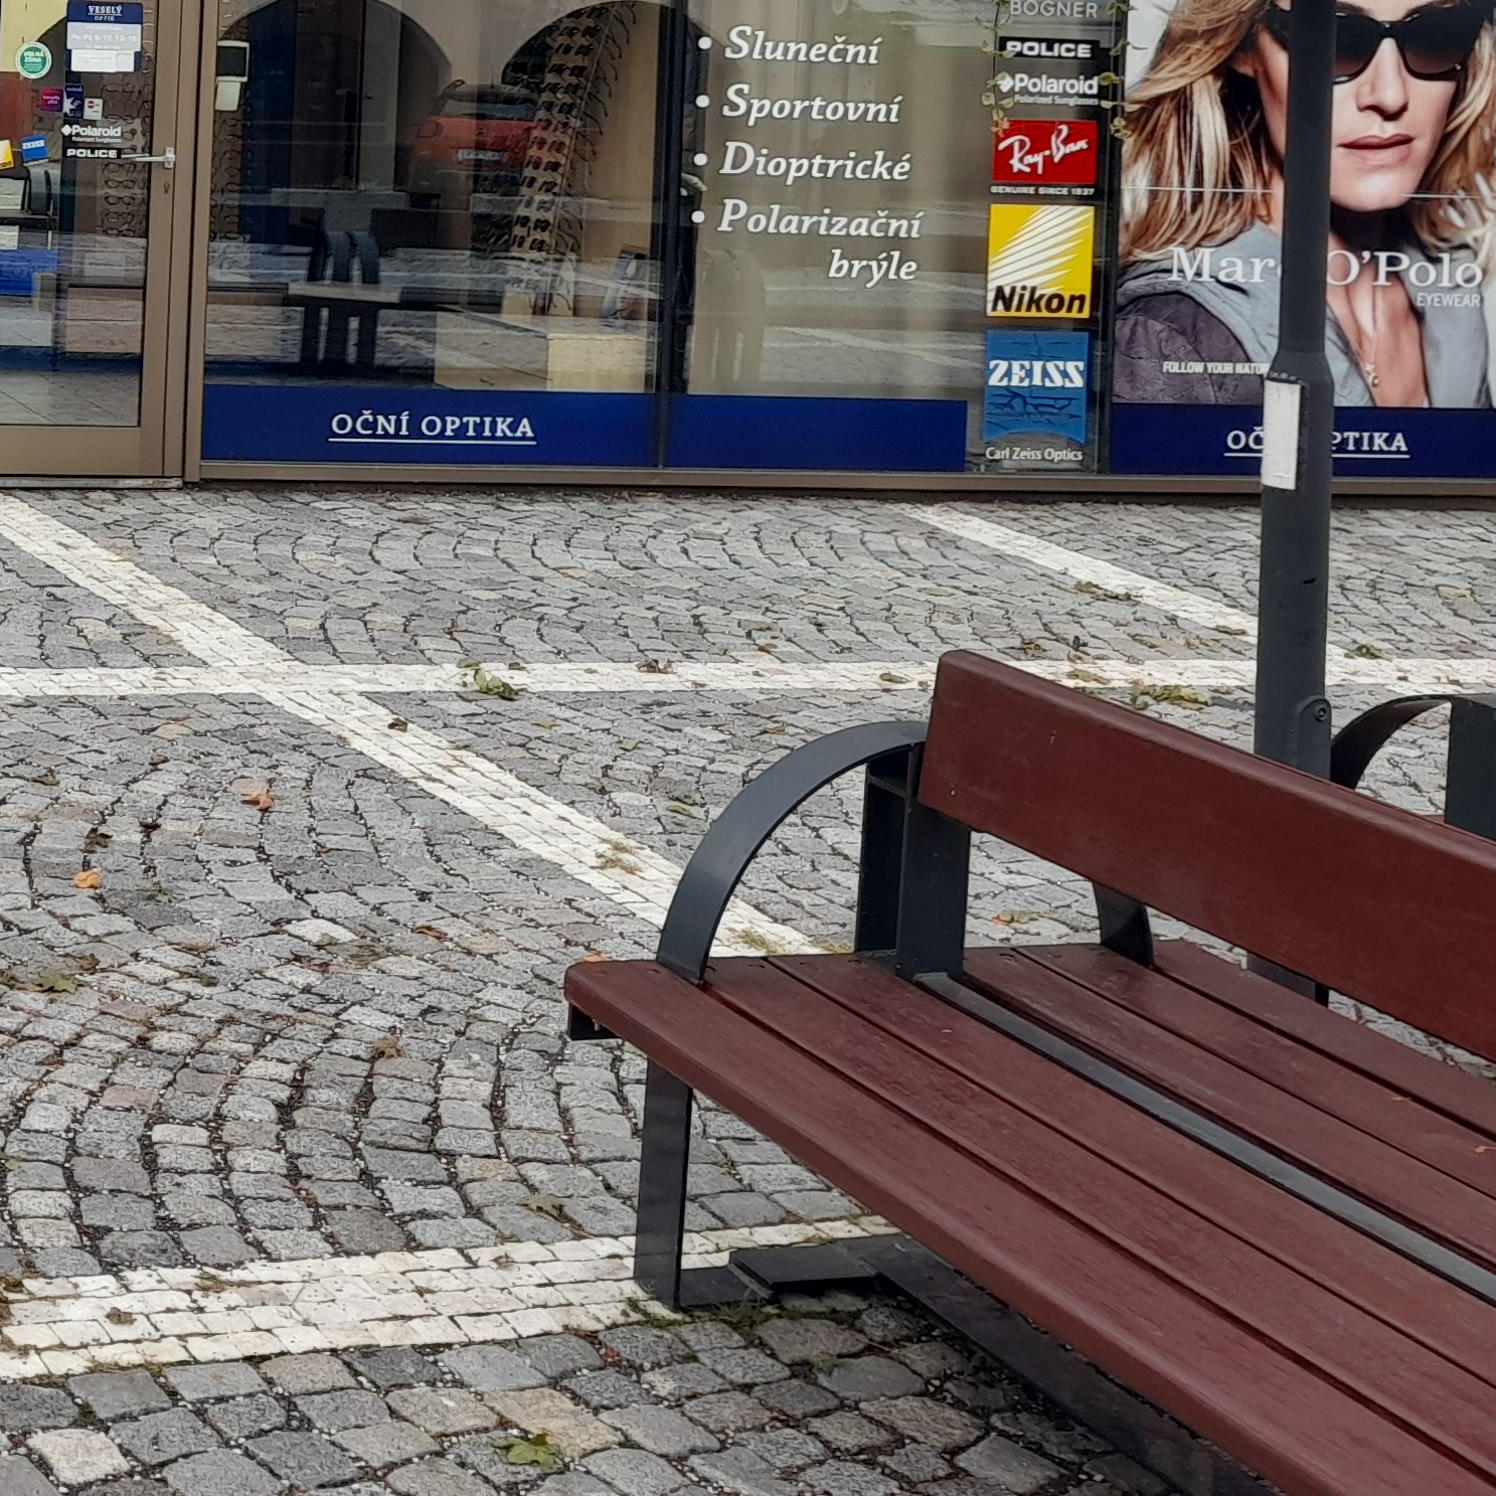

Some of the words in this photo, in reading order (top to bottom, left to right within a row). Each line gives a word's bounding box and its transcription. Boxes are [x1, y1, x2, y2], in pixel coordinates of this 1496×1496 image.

[1010, 0, 1098, 18] BOGNER
[724, 24, 882, 65] Sluneční
[1006, 41, 1092, 58] POLICE
[1014, 73, 1099, 94] Polaroid
[721, 82, 903, 126] Sportovní
[72, 125, 121, 137] Polaroid
[67, 149, 118, 159] POLICE
[719, 141, 912, 185] Dioptrické
[998, 124, 1089, 175] Ray-Ban
[717, 197, 922, 238] Polarizační
[828, 249, 918, 288] brýle
[1167, 247, 1281, 283] Mar
[1327, 250, 1483, 288] O'Polo
[991, 285, 1086, 315] Nikon
[1416, 293, 1481, 308] EYEWEAR
[988, 360, 1084, 388] ZEISS
[1163, 361, 1204, 374] FOLLOW
[1206, 362, 1234, 374] YOUR
[331, 410, 410, 436] OČNÍ
[421, 415, 535, 437] OPTIKA
[1226, 426, 1264, 450] OČ
[986, 447, 1010, 460] Carl
[1012, 447, 1042, 460] Zeiss
[1044, 447, 1083, 463] Optics
